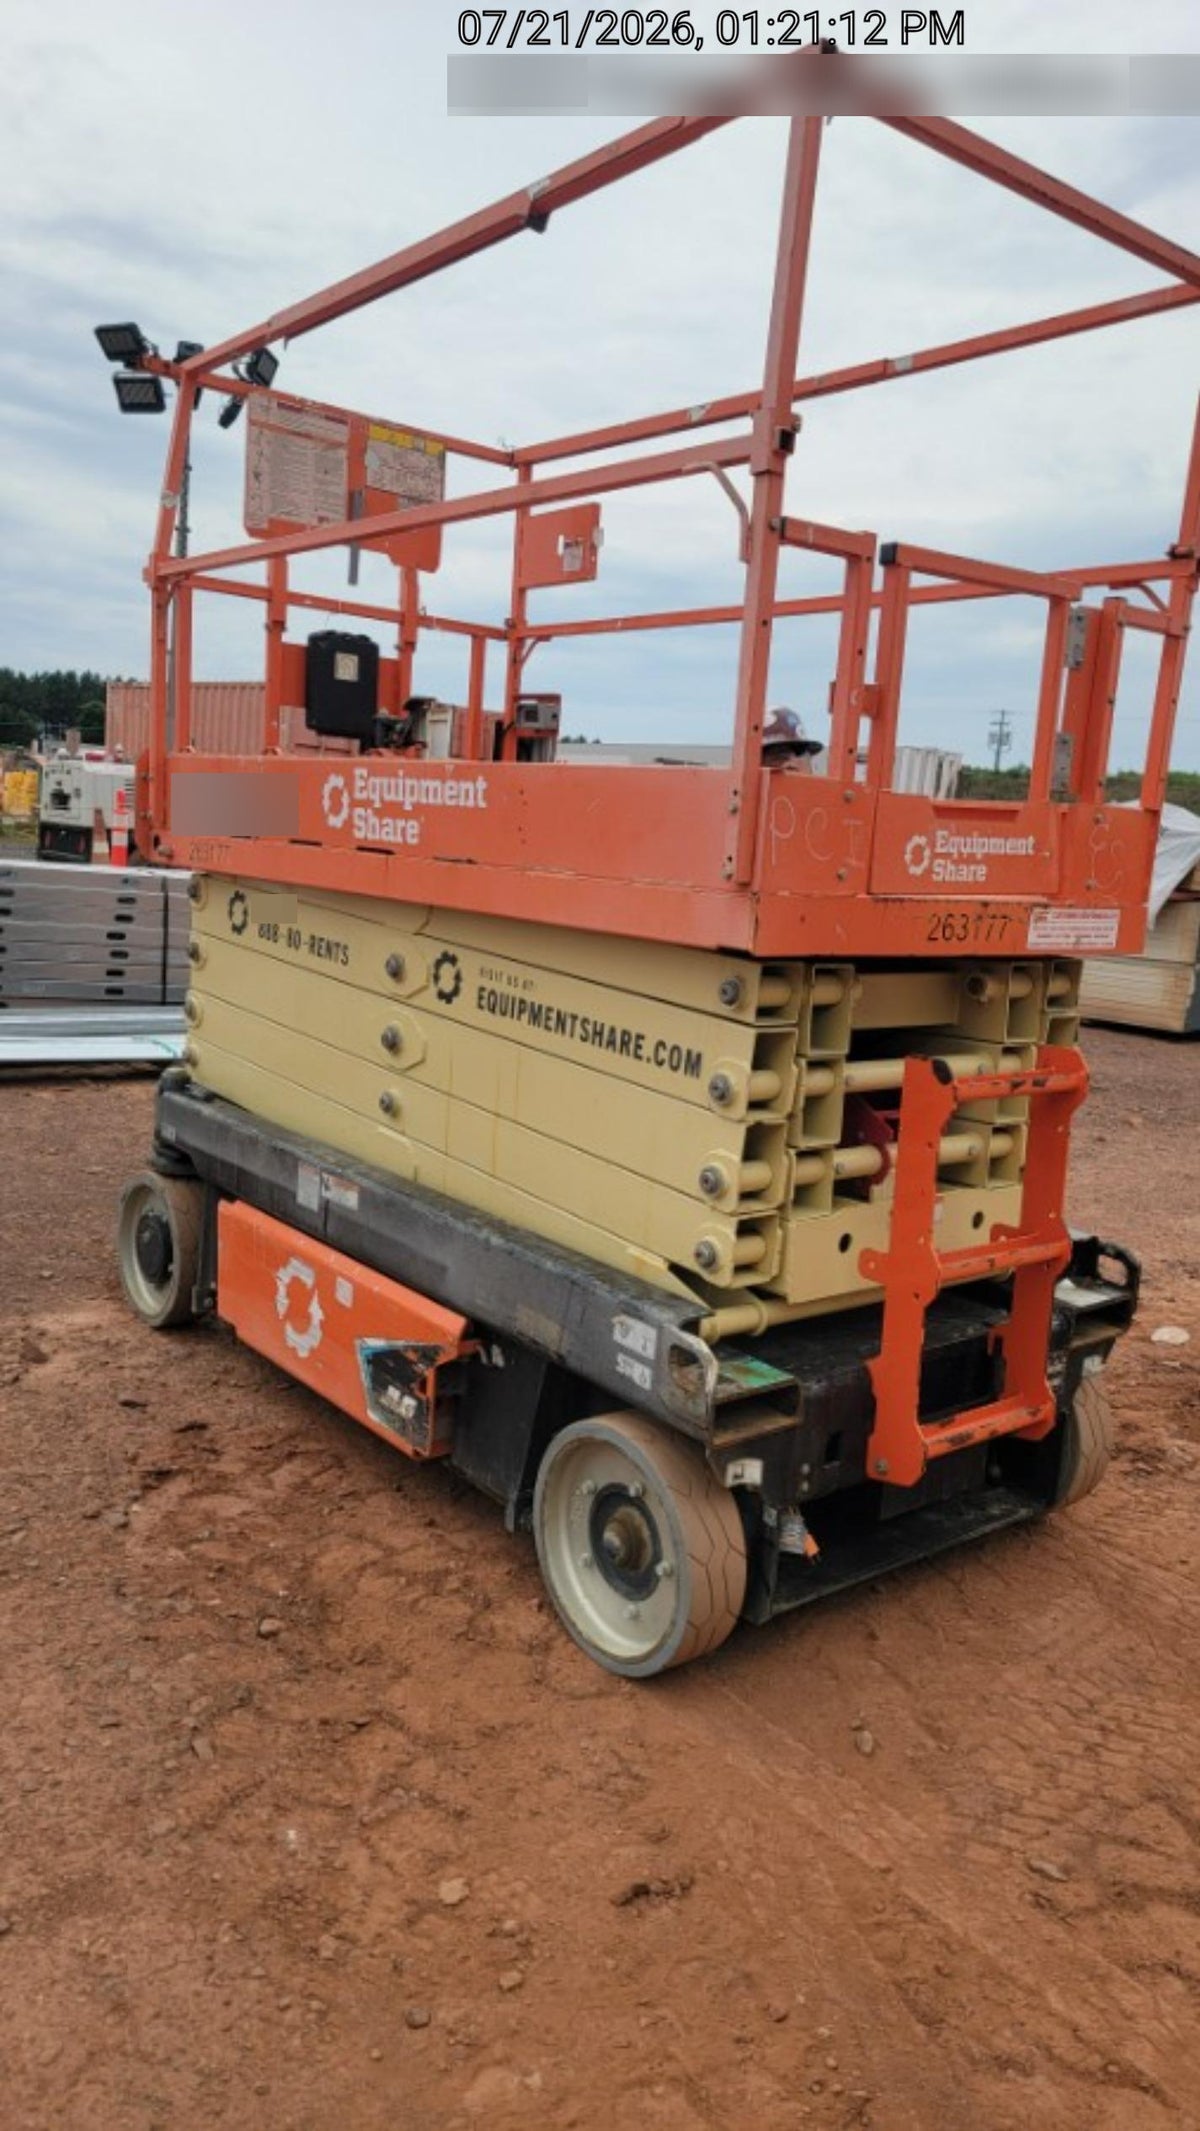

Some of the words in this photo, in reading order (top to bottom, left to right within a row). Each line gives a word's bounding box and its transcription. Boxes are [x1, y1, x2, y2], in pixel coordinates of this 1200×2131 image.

[352, 767, 488, 810] Equipment
[352, 807, 420, 845] Share
[933, 829, 1036, 858] Equipment
[931, 859, 988, 882] Share
[927, 913, 1011, 942] 263177
[475, 985, 703, 1079] EQUIPMENTSHARE.COM
